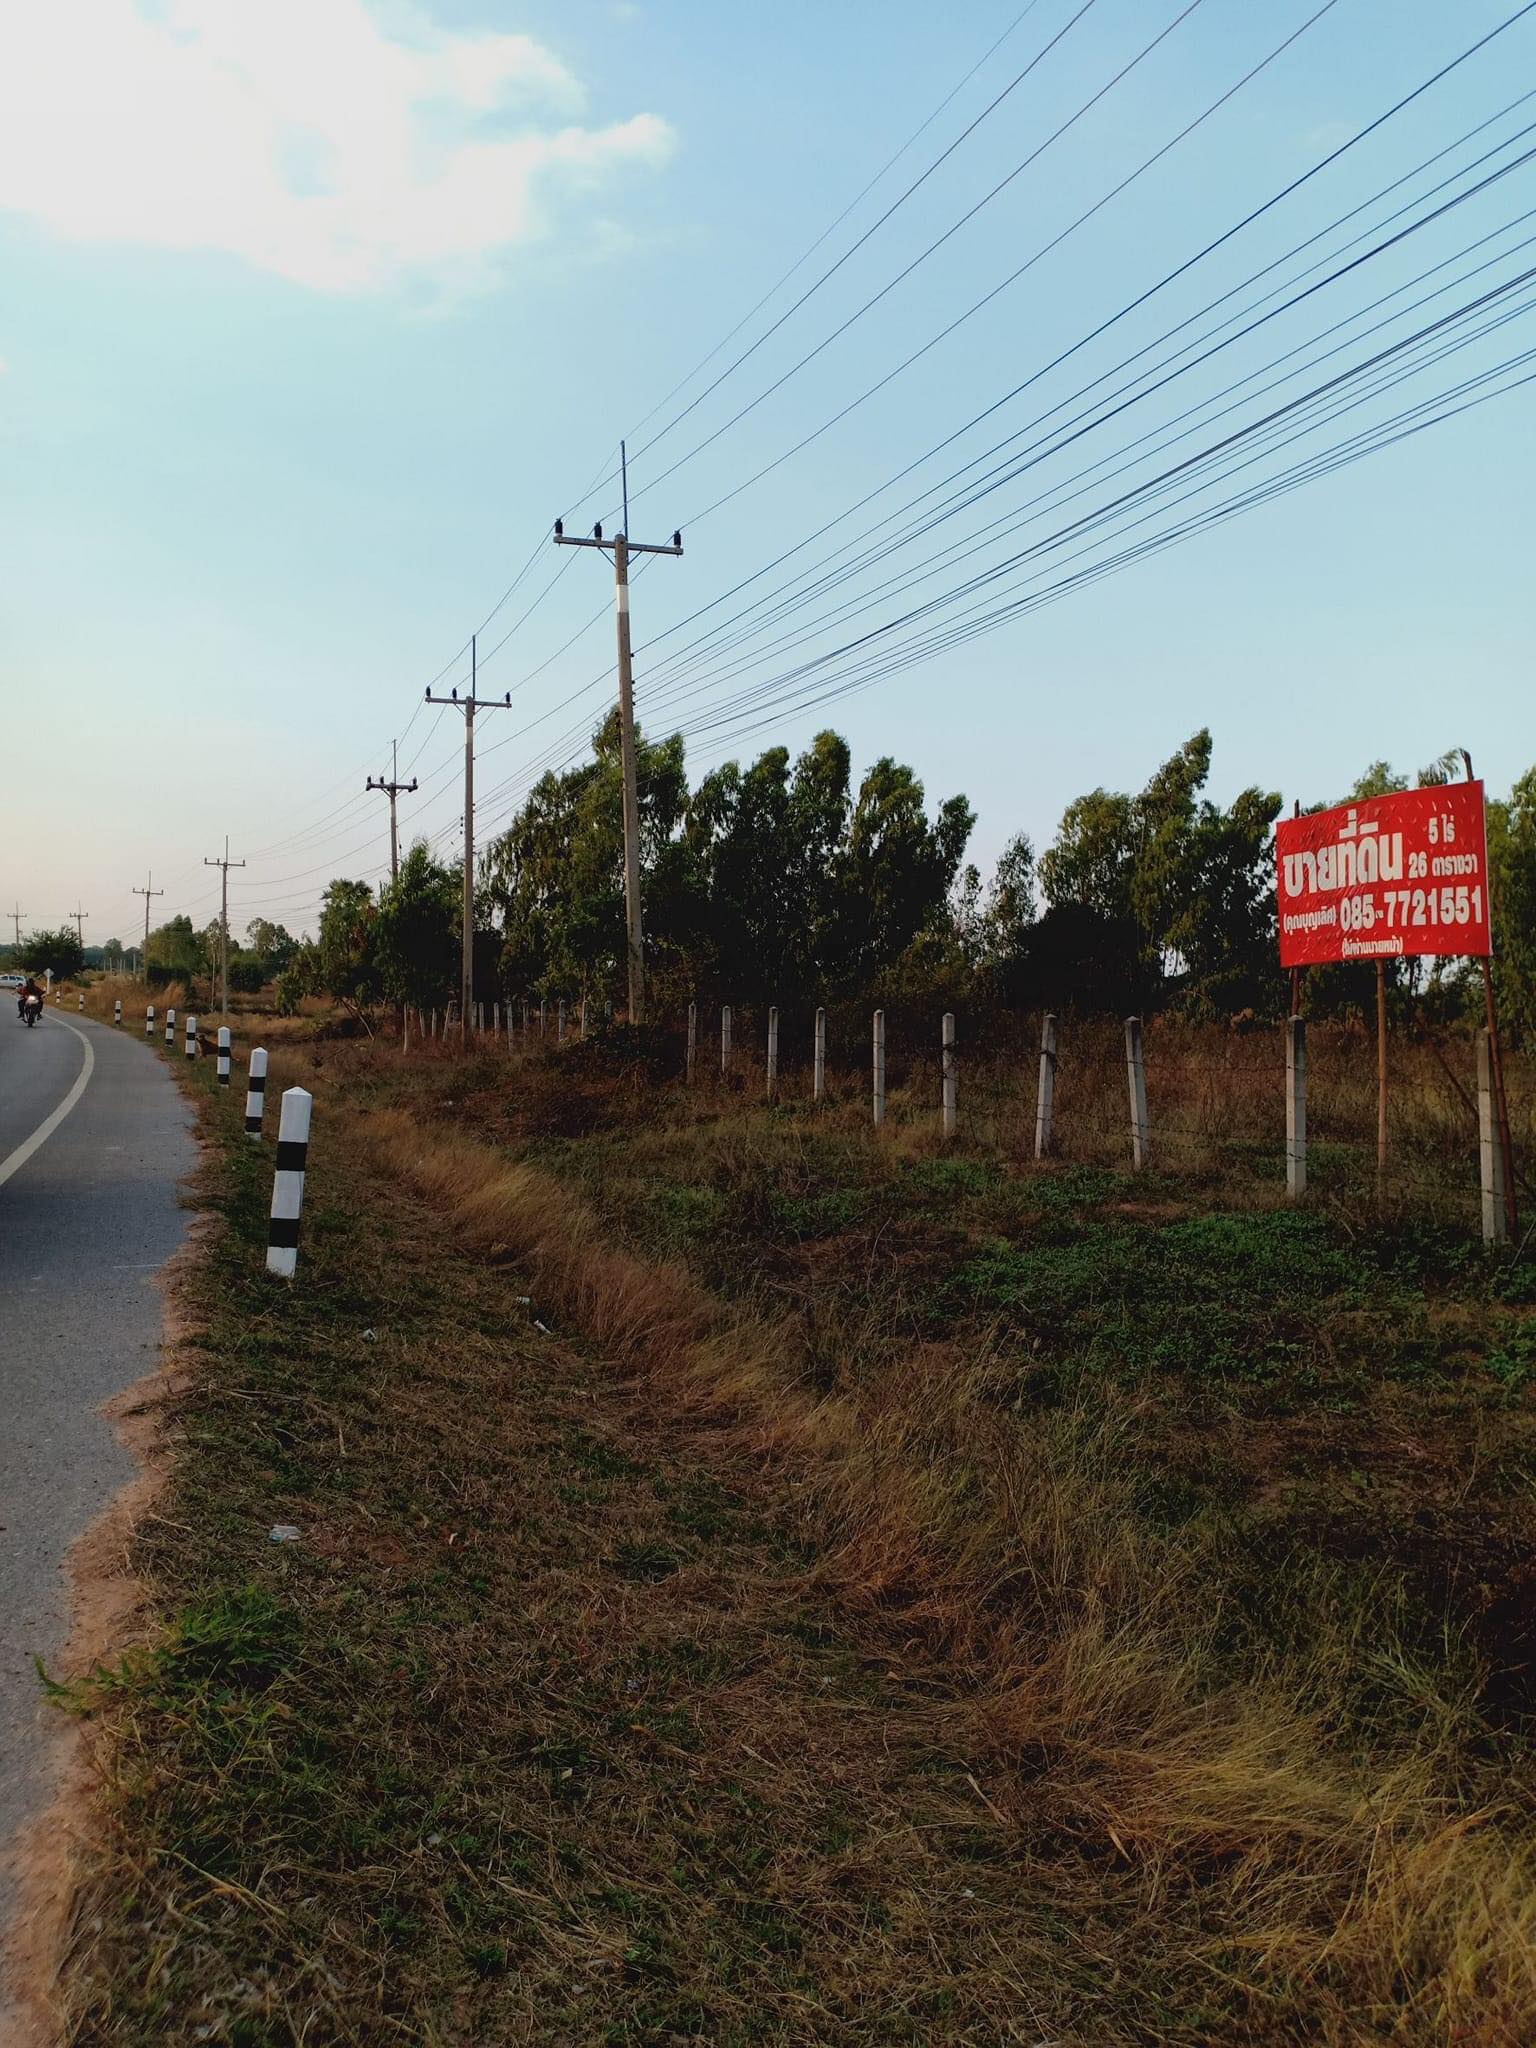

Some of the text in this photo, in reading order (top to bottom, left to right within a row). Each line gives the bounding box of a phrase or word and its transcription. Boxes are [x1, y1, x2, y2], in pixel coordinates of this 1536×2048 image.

[1428, 813, 1455, 844] 5 ไร่
[1282, 808, 1403, 898] ขายที่ดิน
[1408, 851, 1478, 879] 26 ตารางวา
[1339, 885, 1483, 931] 085-7721551
